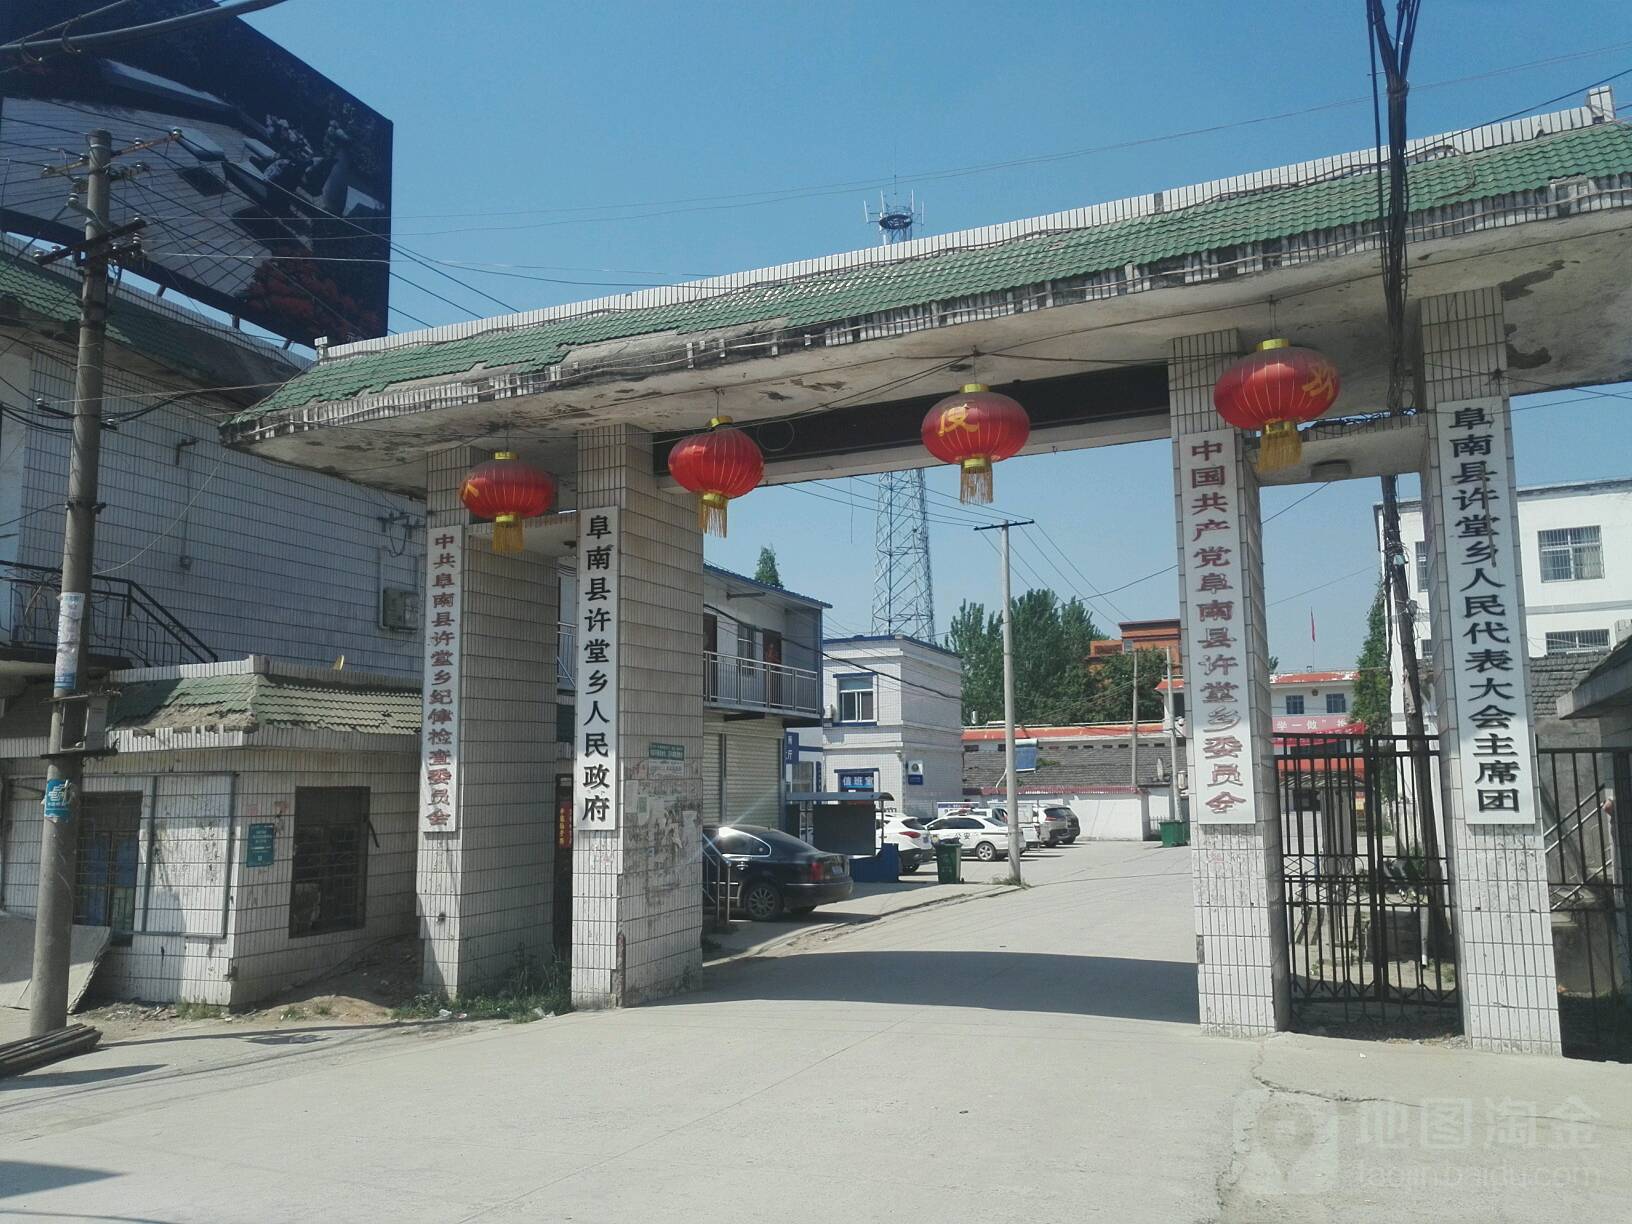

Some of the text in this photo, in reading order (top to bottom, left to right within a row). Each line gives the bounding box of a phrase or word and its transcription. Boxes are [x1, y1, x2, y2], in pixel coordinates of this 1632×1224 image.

[426, 534, 456, 827] 中共阜南县许堂乡纪律检查委员会
[582, 515, 613, 822] 阜南县许堂乡人民政府
[1191, 440, 1246, 814] 中国共产党阜南县许堂乡委员会
[1449, 407, 1520, 813] 阜南县许堂乡人民代表大会主席团
[842, 775, 874, 788] 值班室
